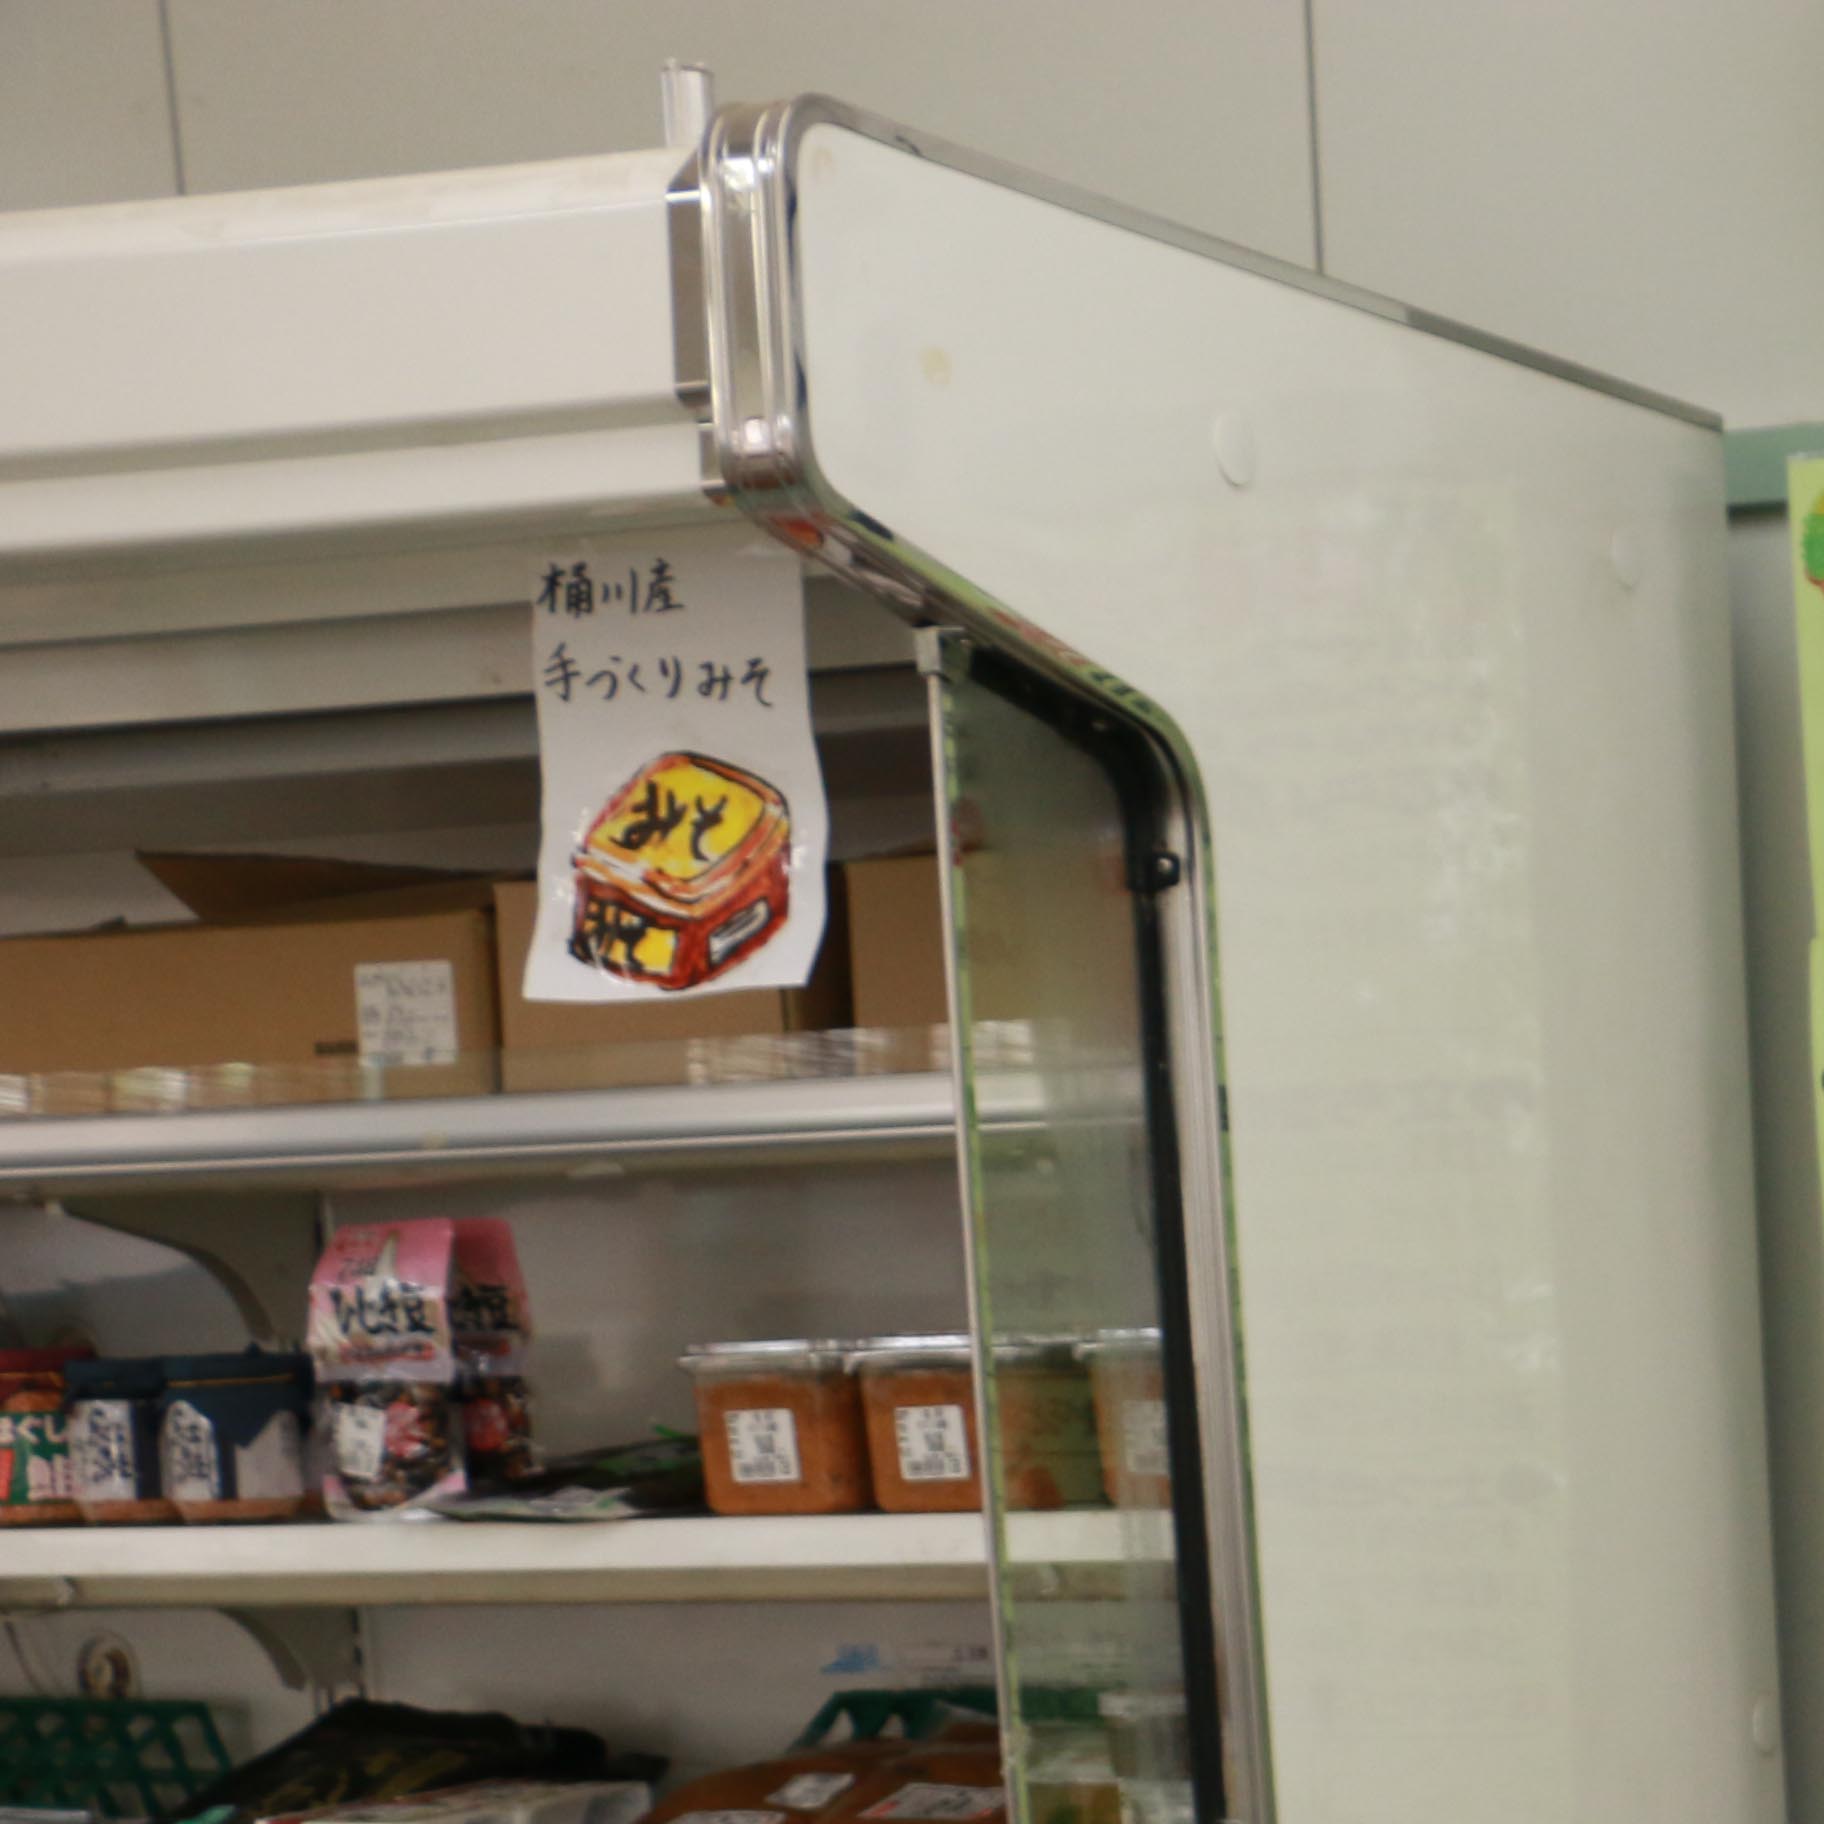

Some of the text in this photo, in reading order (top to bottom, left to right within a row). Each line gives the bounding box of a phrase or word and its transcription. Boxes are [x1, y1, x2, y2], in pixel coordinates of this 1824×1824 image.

[538, 560, 685, 615] 桶川産
[545, 643, 774, 707] 手づくりみそ
[611, 780, 728, 860] みそ
